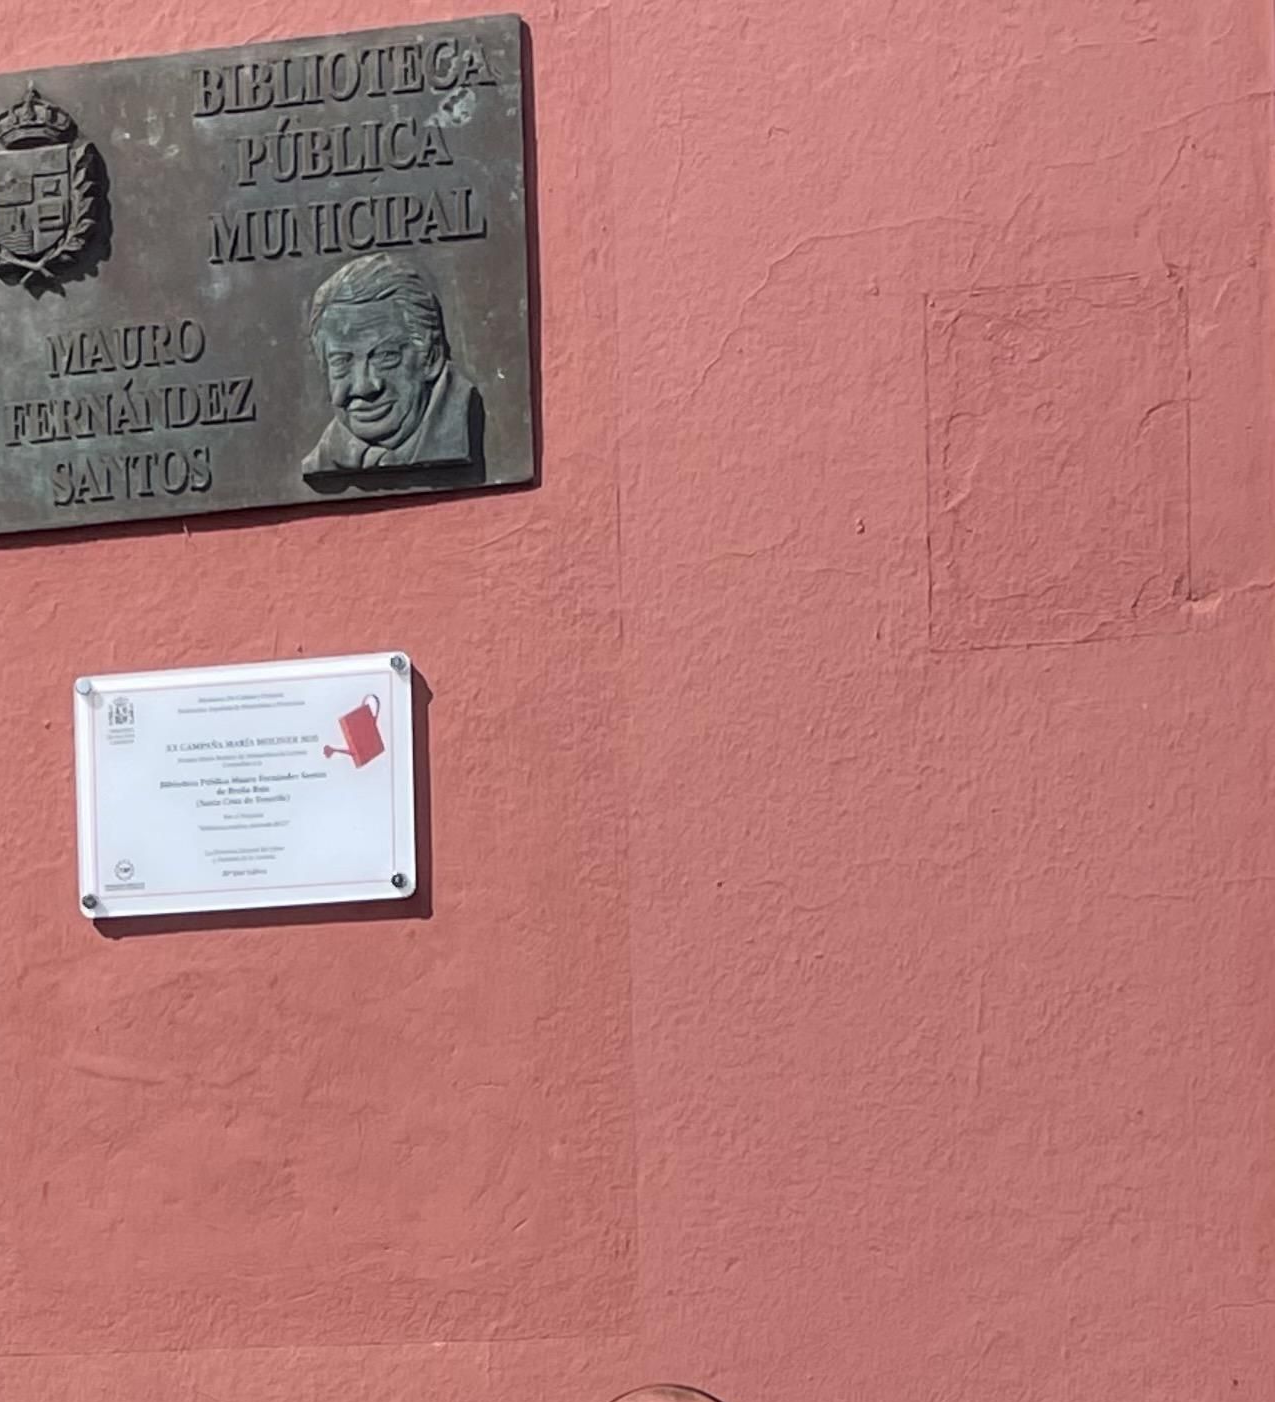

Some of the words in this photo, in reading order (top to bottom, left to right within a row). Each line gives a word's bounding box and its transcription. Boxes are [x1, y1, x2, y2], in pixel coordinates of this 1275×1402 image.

[191, 36, 500, 118] BIBLIOTECA
[236, 117, 453, 186] PÚBLICA
[207, 188, 487, 264] MUNICIPAL
[45, 318, 206, 378] MAURO
[4, 377, 257, 447] FERNÁNDEZ
[52, 447, 213, 508] SANTOS
